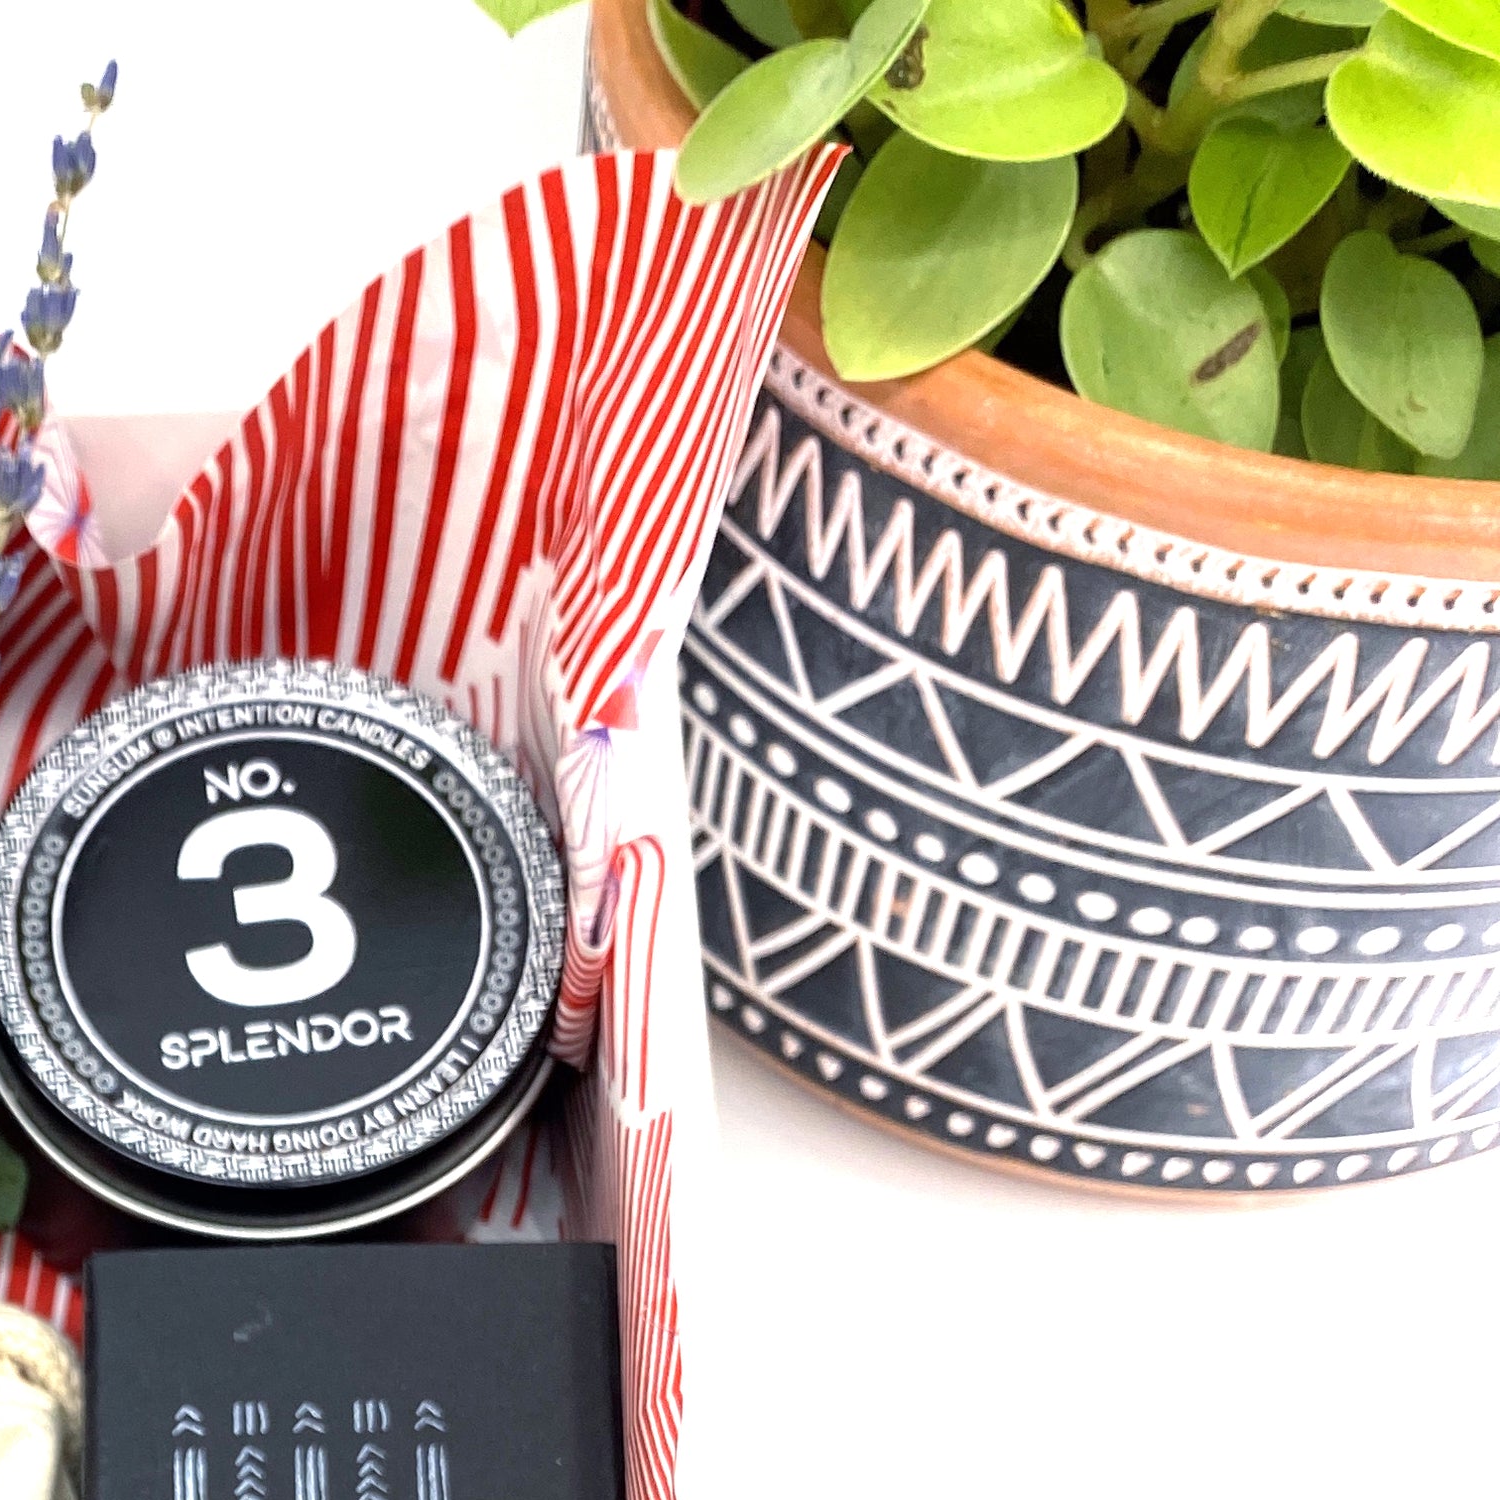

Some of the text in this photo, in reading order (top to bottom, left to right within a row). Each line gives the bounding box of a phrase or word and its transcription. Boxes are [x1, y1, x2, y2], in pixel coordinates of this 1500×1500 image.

[176, 704, 316, 740] INTENTION
[317, 709, 433, 771] CANDLES
[203, 760, 296, 804] NO.
[176, 806, 358, 1008] 3
[160, 1006, 414, 1072] SPLENDOR
[394, 1047, 471, 1117] LEARN
[115, 1089, 192, 1141] WORK
[193, 1122, 270, 1154] HARD
[273, 1119, 359, 1154] DOING
[363, 1104, 395, 1135] BY
